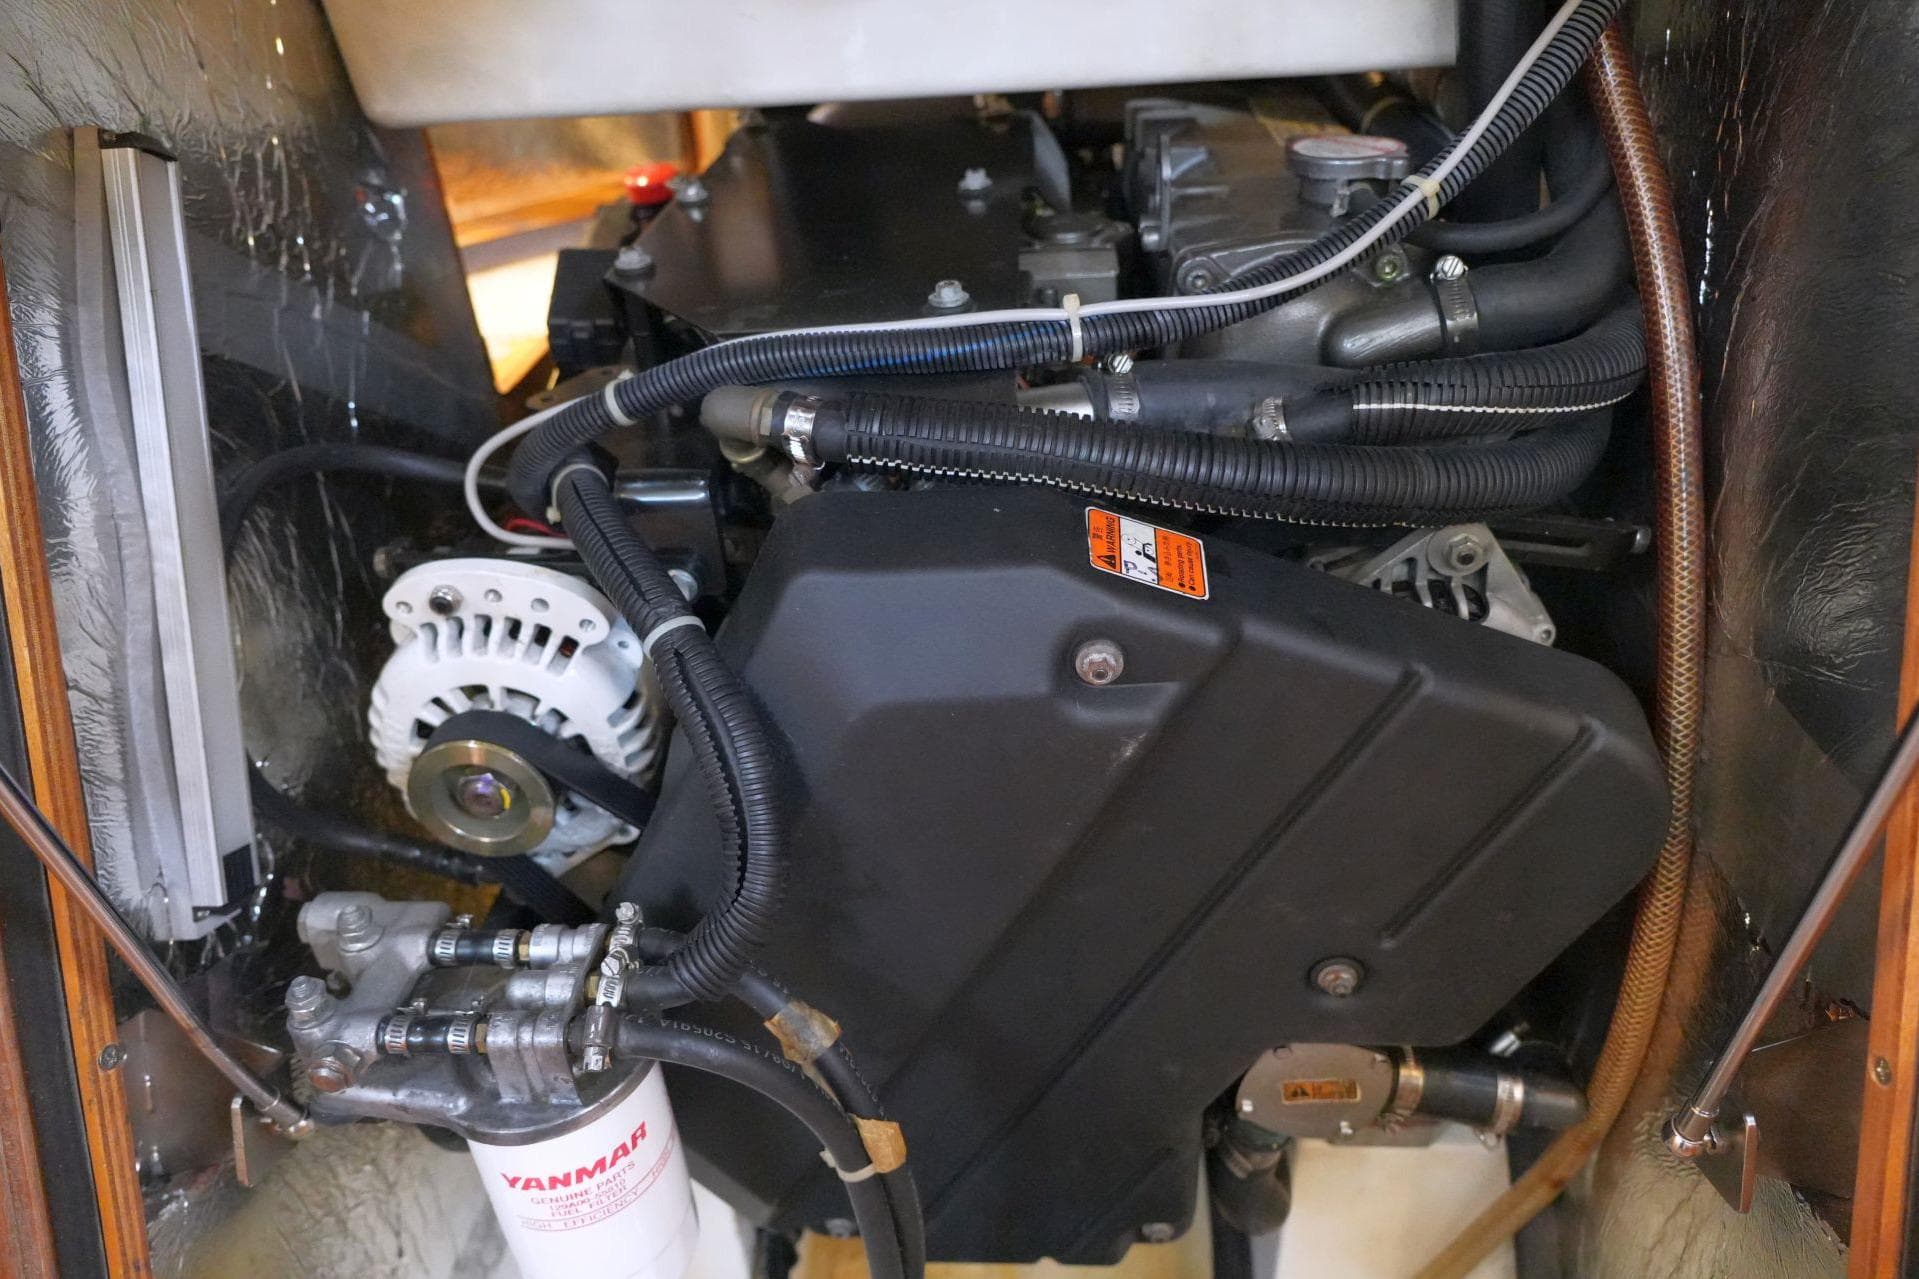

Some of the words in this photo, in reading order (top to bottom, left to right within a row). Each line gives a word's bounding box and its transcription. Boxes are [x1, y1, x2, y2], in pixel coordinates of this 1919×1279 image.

[1105, 516, 1116, 553] WARNING
[499, 1120, 647, 1191] YANMAR
[530, 1187, 593, 1205] GENUINE
[596, 1161, 636, 1192] PARTS
[550, 1207, 582, 1218] FUEL
[589, 1185, 629, 1210] FILTER
[563, 1188, 640, 1229] EFFICIENCY
